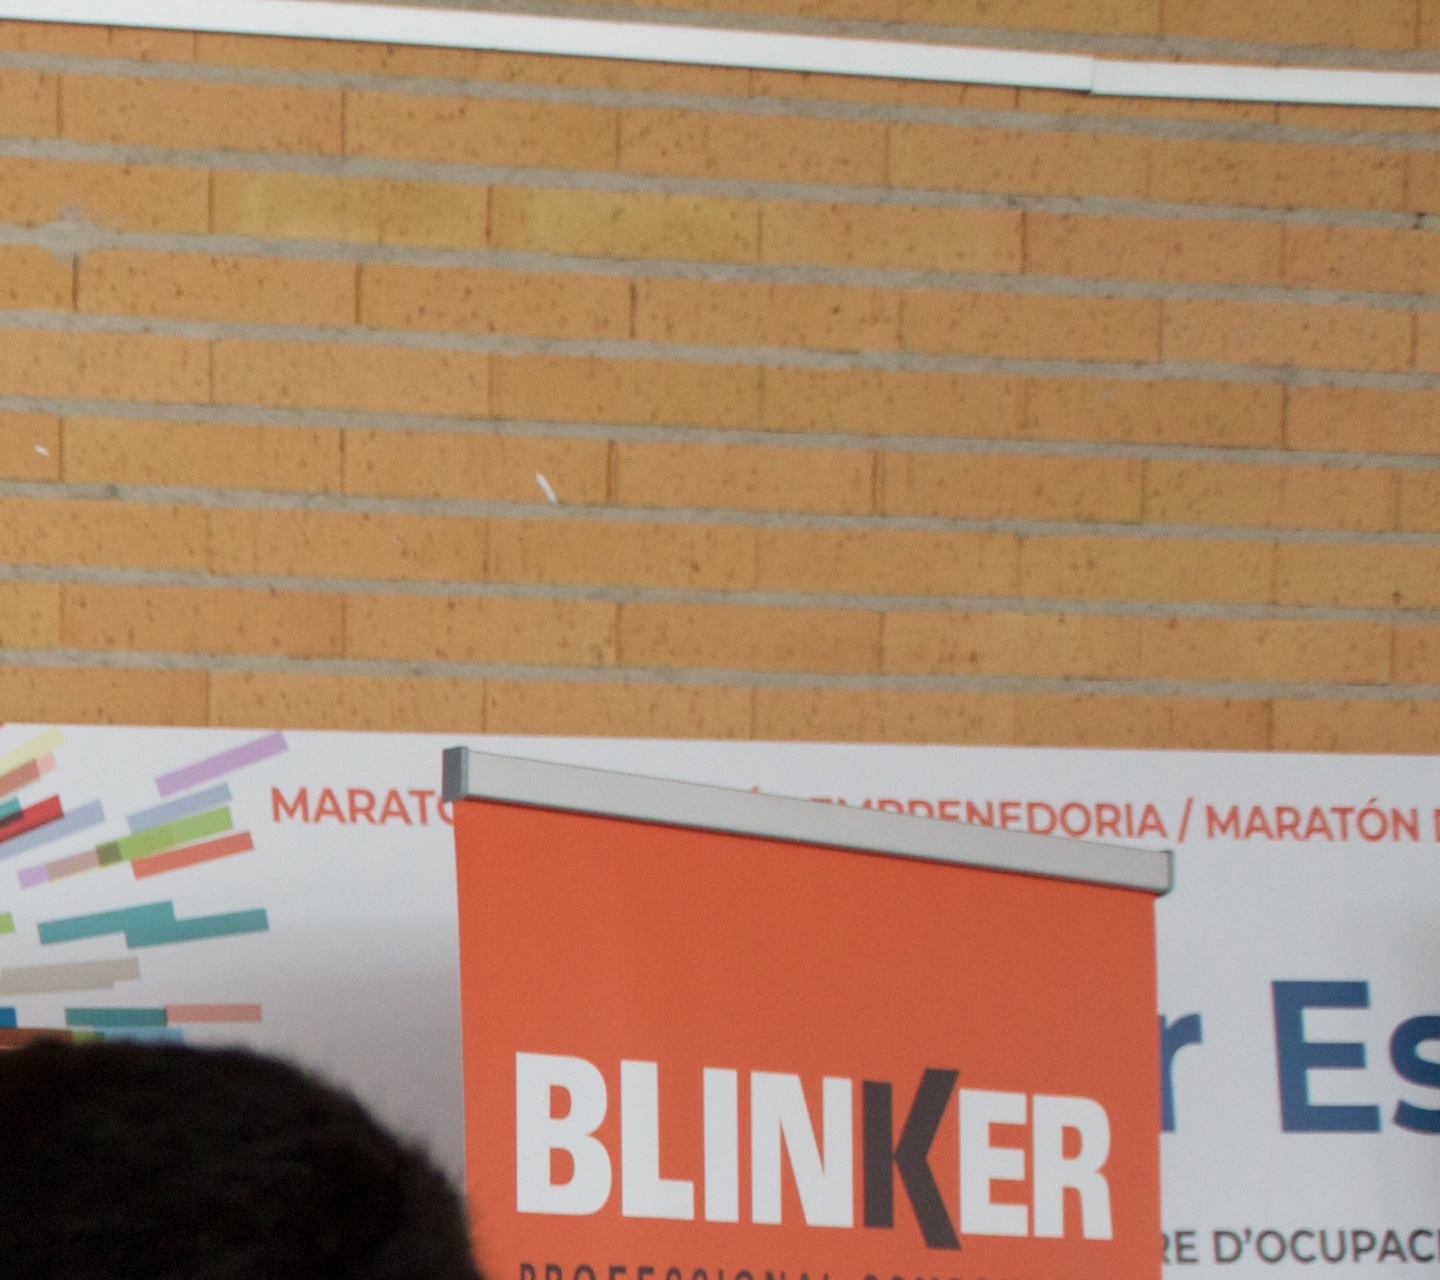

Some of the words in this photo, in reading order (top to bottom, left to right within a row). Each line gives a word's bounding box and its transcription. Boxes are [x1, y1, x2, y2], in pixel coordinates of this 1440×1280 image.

[1178, 796, 1194, 843] /
[1207, 797, 1420, 843] MARATÓN
[515, 1051, 1114, 1251] BLINKER
